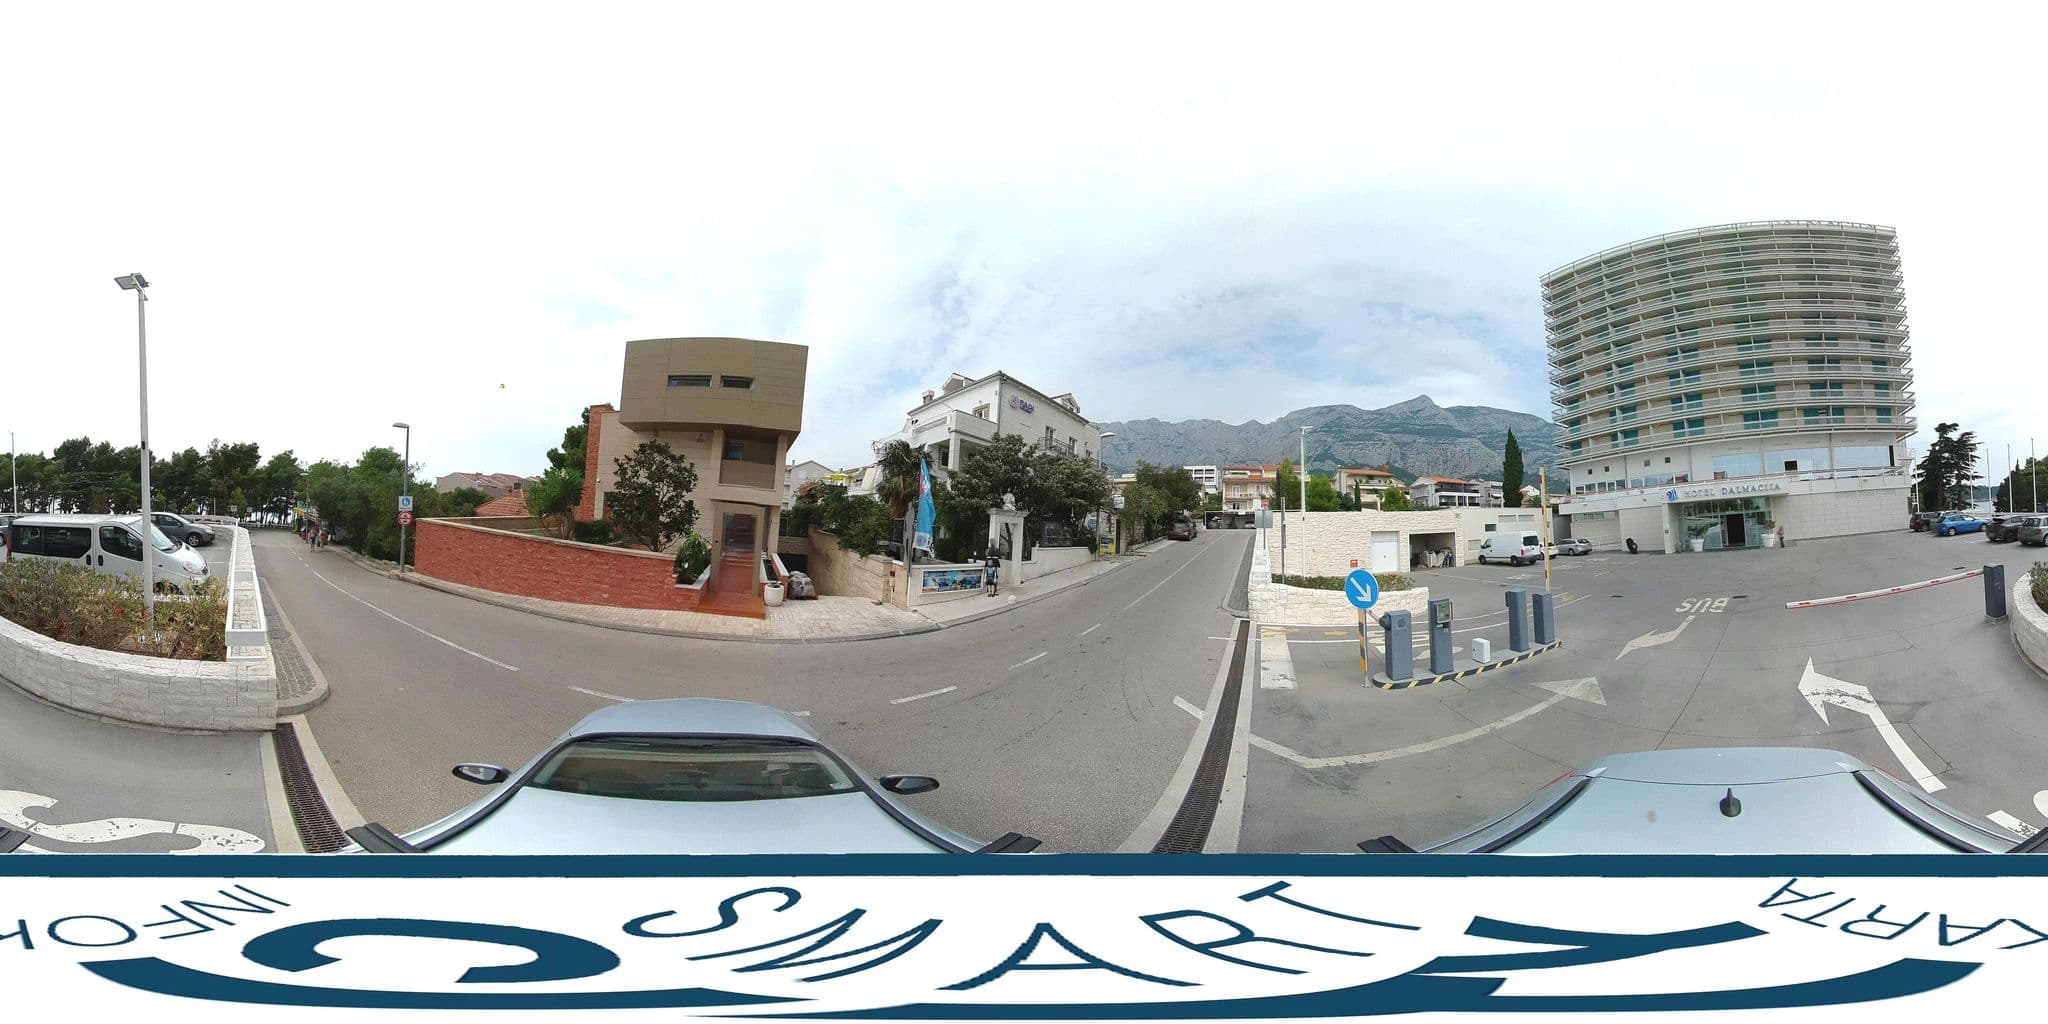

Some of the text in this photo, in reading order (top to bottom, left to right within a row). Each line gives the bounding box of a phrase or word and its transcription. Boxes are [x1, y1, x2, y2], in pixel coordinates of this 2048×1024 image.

[1684, 482, 1781, 499] HOTEL DALMACIJA
[1675, 597, 1730, 613] BUS
